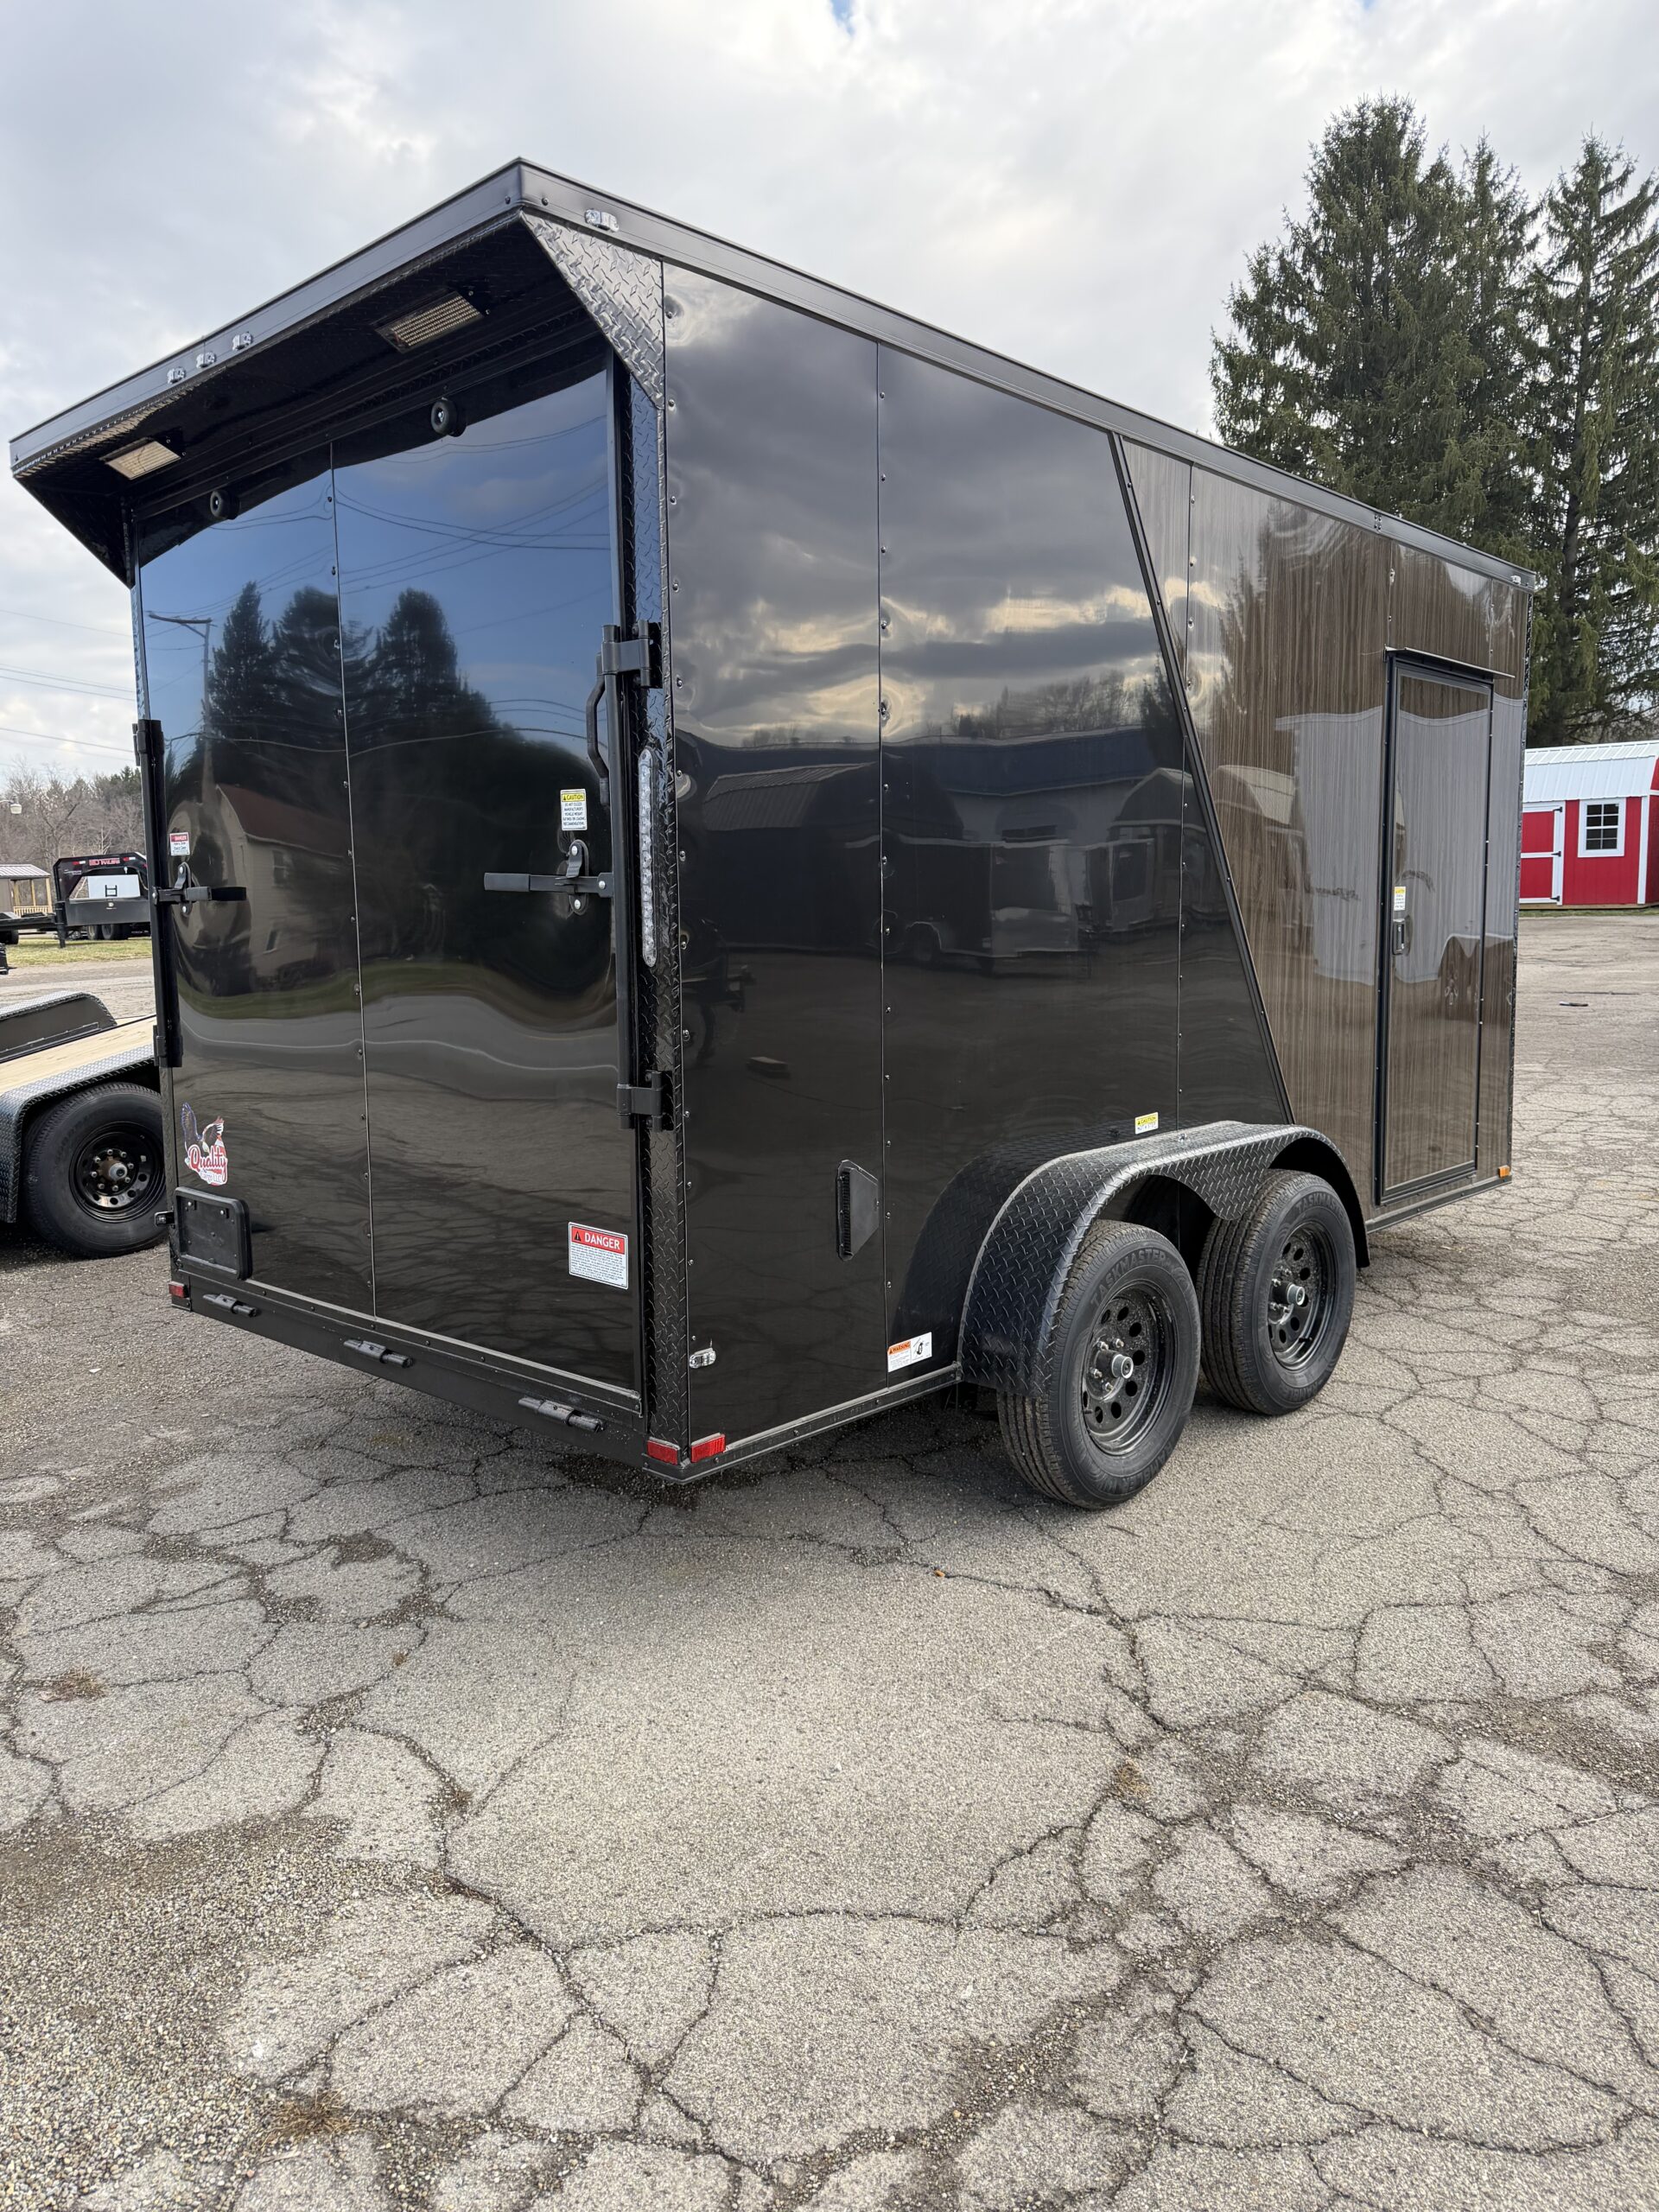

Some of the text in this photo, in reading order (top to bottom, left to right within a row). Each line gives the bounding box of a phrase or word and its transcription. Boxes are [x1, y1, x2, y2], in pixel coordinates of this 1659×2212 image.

[188, 1146, 227, 1182] Quality
[584, 1232, 620, 1250] DANGER
[1090, 1249, 1167, 1306] TASKMASTER
[893, 1342, 910, 1352] WARNING
